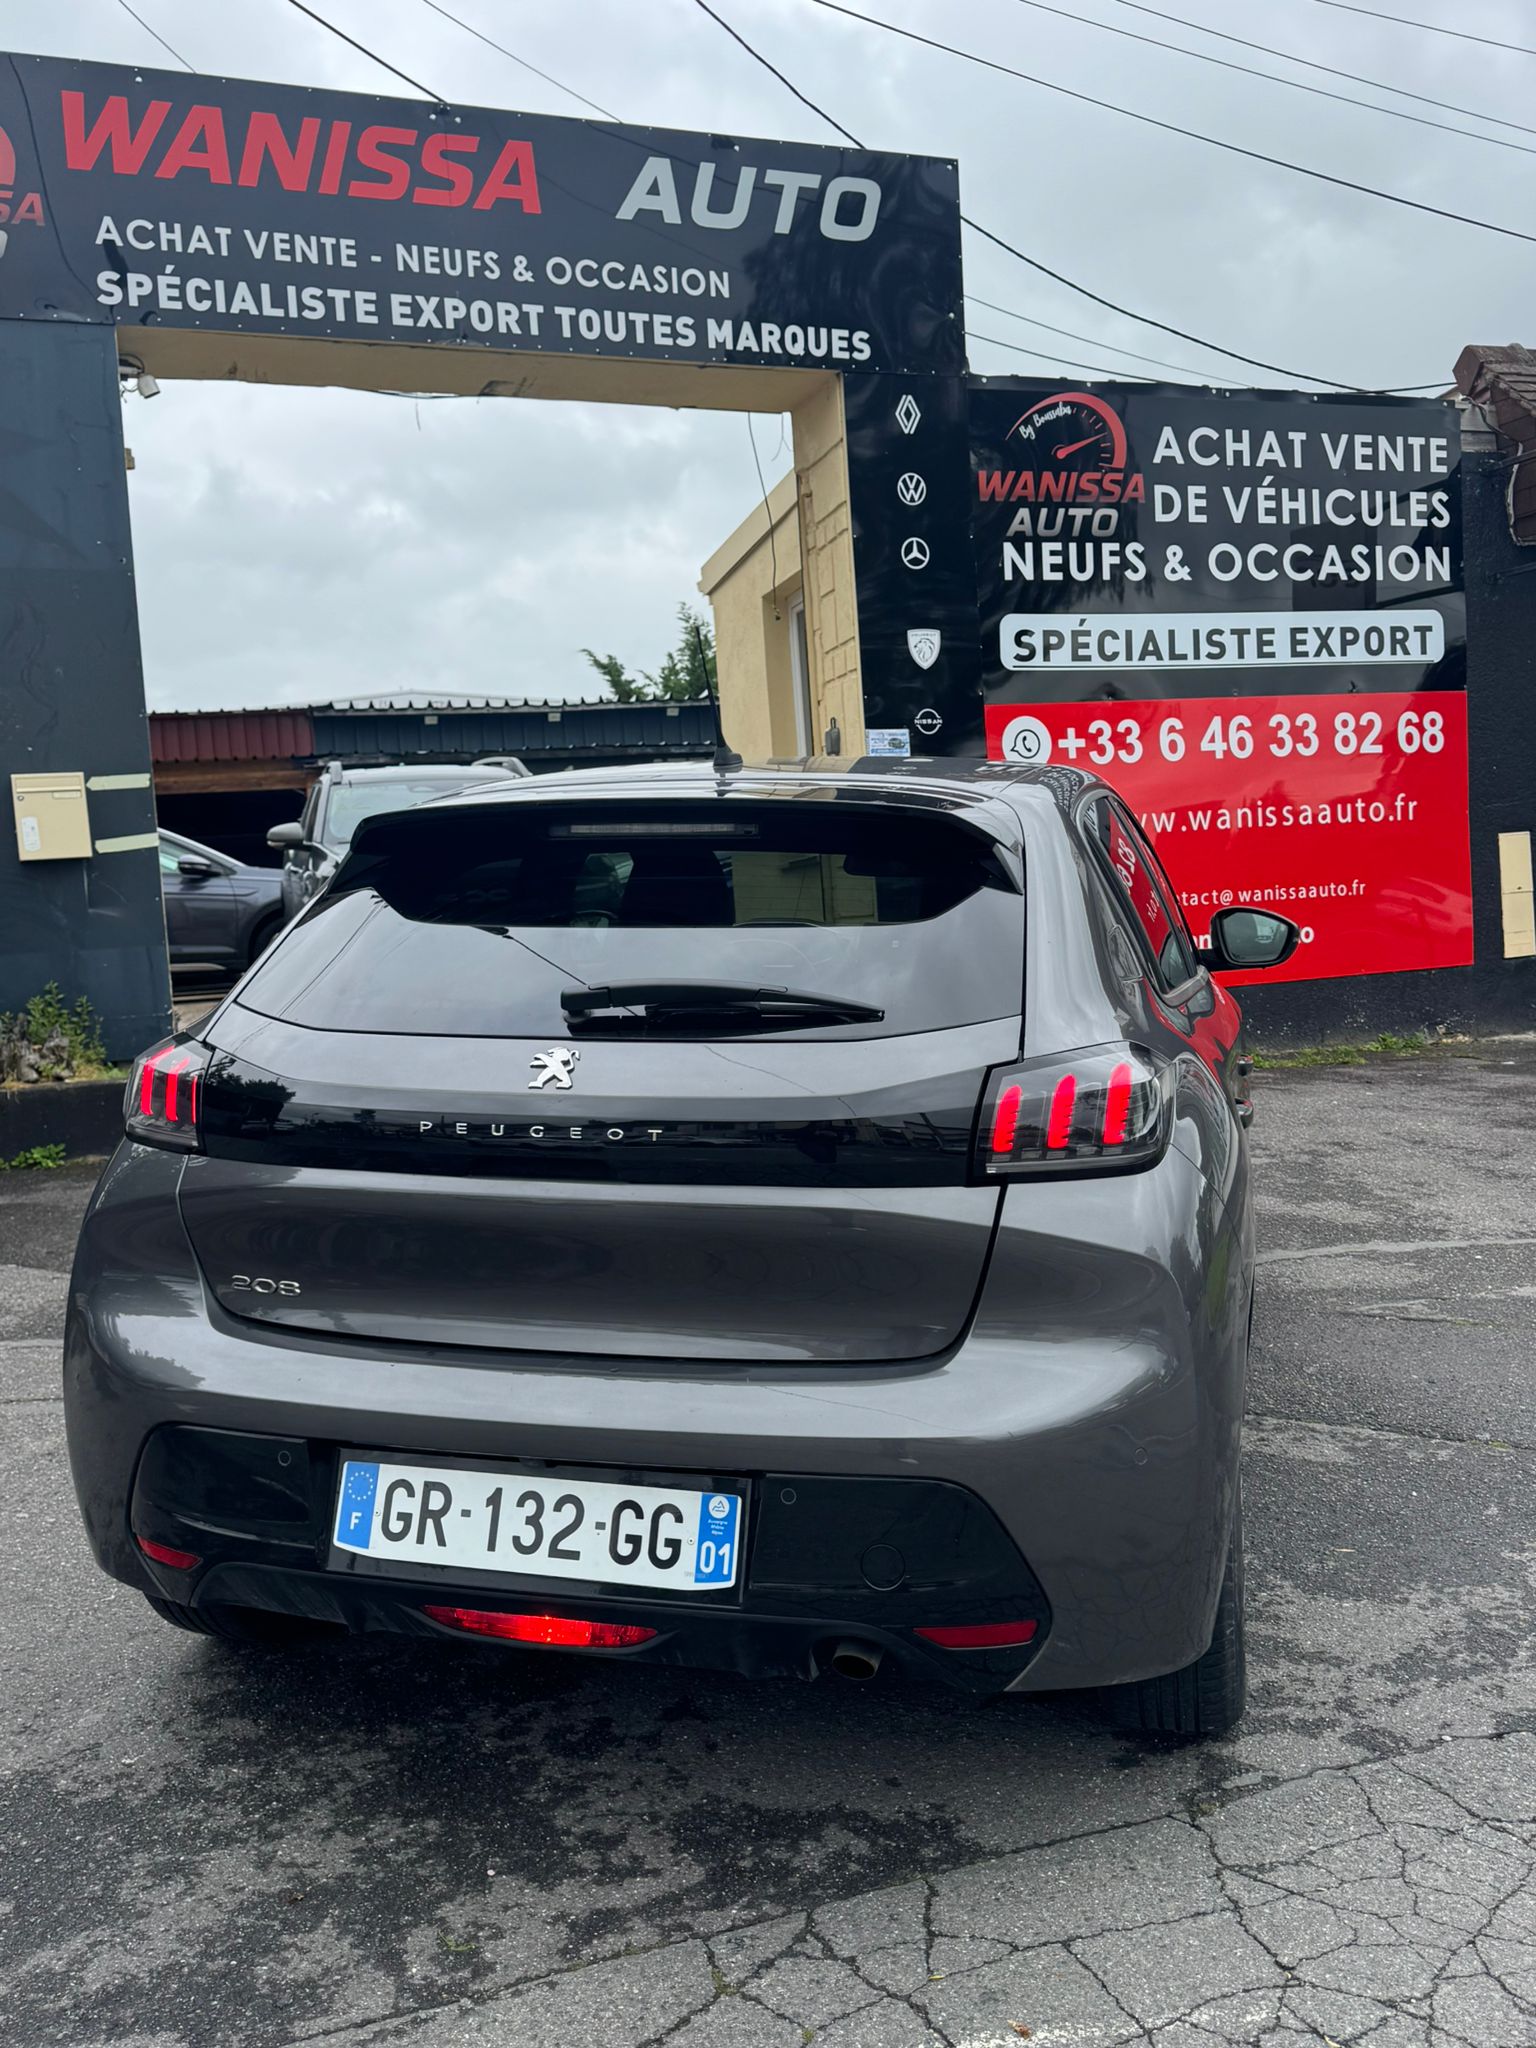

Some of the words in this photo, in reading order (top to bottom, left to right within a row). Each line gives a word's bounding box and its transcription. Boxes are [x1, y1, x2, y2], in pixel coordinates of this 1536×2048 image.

[60, 90, 541, 215] WANISSA
[614, 154, 884, 242] AUTO
[95, 215, 232, 257] ACHAT
[243, 229, 358, 268] VENTE
[394, 242, 501, 285] NEUFS
[512, 254, 536, 284] &
[545, 255, 731, 300] OCCASION
[95, 264, 380, 325] SPÉCIALISTE
[390, 292, 545, 337] EXPORT
[553, 304, 697, 350] TOUTES
[706, 317, 873, 362] MARQUES
[1152, 426, 1307, 468] ACHAT
[1321, 432, 1449, 474] VENTE
[978, 470, 1146, 504] WANISSA
[1153, 484, 1208, 524] DE
[1222, 475, 1451, 529] VÉHICULES
[1005, 507, 1119, 538] AUTO
[1002, 541, 1148, 582] NEUFS
[1163, 544, 1193, 582] &
[1207, 542, 1451, 583] OCCASION
[1013, 618, 1277, 663] SPÉCIALISTE
[1289, 625, 1434, 659] EXPORT
[1058, 718, 1145, 766] +33
[1158, 717, 1187, 763] 6
[1200, 714, 1255, 760] 46
[1268, 712, 1320, 758] 33
[1333, 711, 1384, 756] 82
[1397, 710, 1445, 754] 68
[419, 1120, 663, 1142] PEUGEOT
[231, 1274, 301, 1297] 208
[349, 1511, 362, 1531] F
[380, 1478, 685, 1571] GR-132-GG
[700, 1540, 731, 1576] 01
